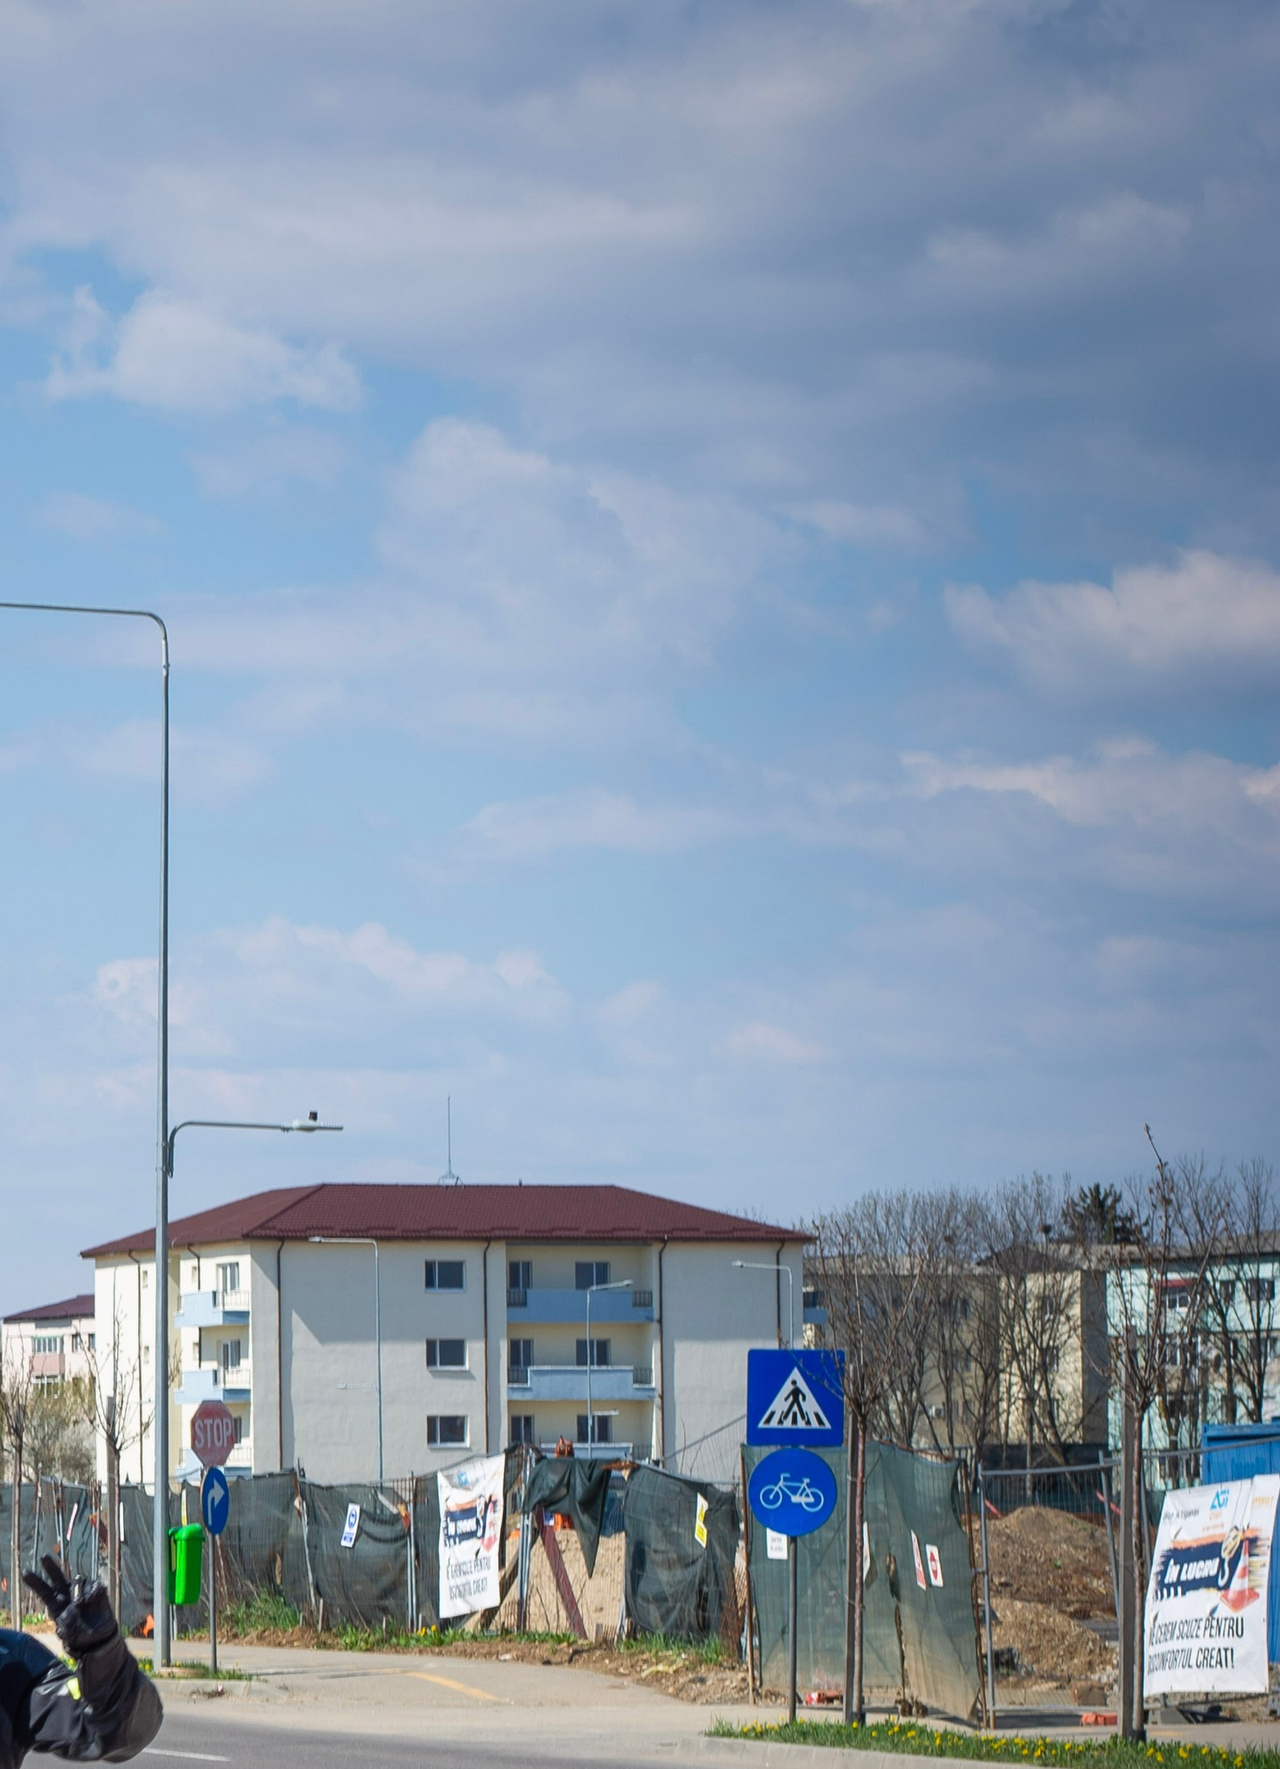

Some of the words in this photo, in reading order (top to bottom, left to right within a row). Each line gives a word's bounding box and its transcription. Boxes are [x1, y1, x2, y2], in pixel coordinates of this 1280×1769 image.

[194, 1418, 232, 1449] STOP
[1180, 1557, 1220, 1582] LUCRU
[1176, 1617, 1202, 1640] SCUZE
[1202, 1616, 1245, 1639] PENTRU
[1195, 1647, 1235, 1669] CREAT!
